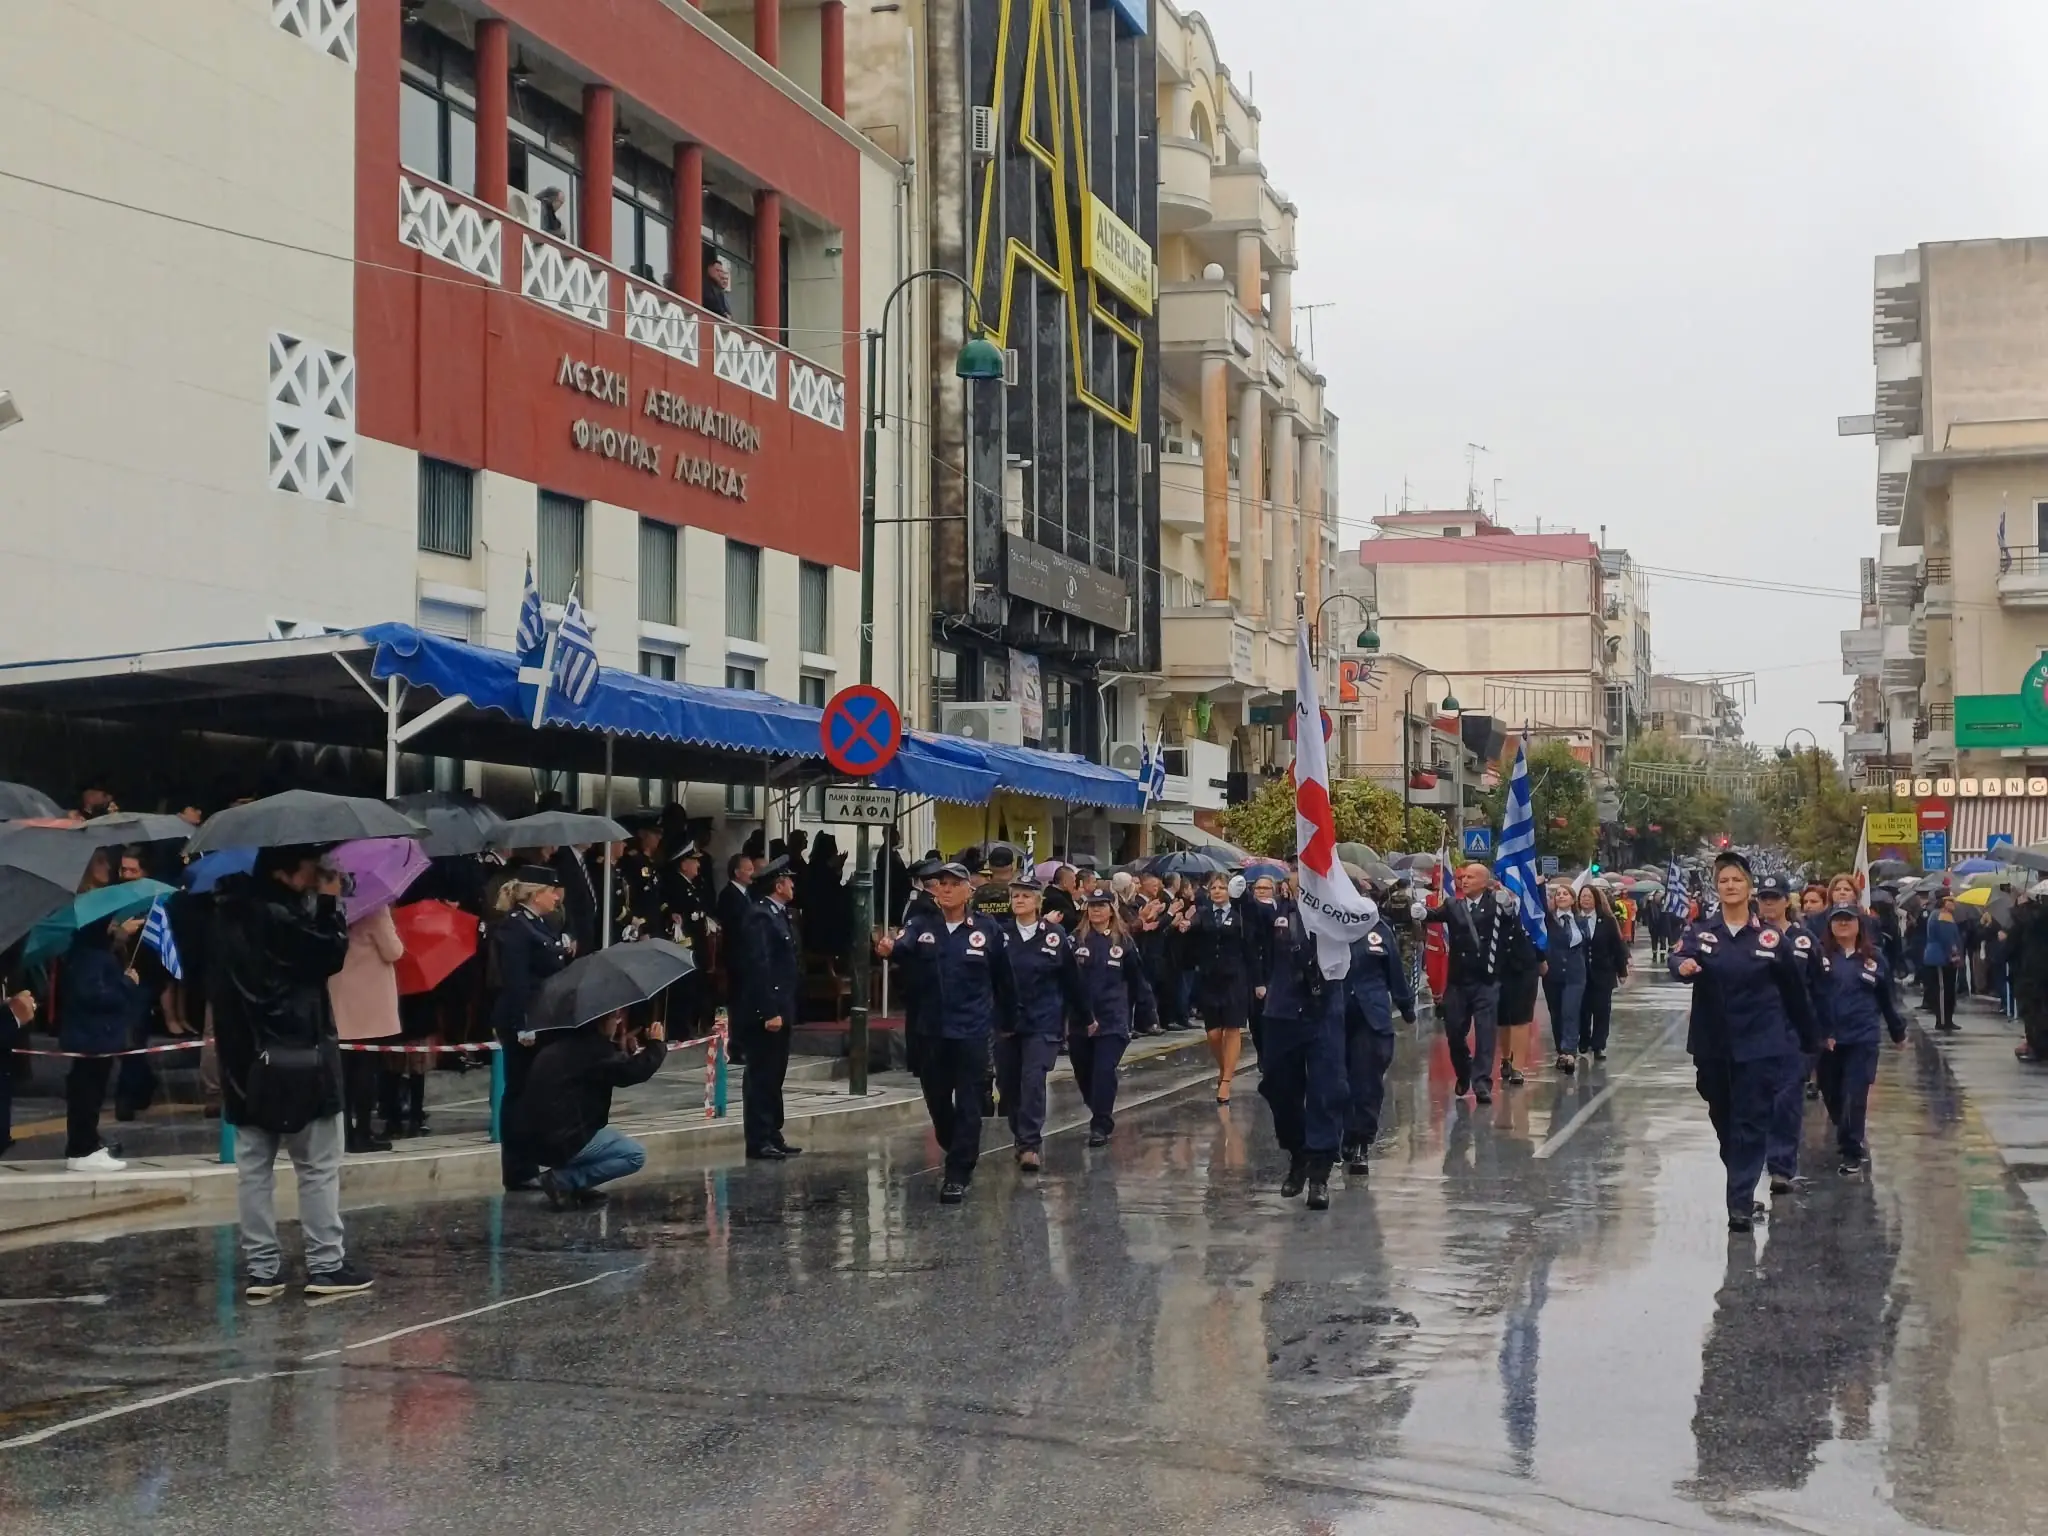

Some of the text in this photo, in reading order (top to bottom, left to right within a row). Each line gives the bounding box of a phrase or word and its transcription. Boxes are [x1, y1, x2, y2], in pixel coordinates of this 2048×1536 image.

[1097, 212, 1148, 282] ALTERLIFE
[557, 353, 761, 454] ΛΕΣΧΗ ΑΞΙΩΜΑΤΙΚΩΝ
[572, 418, 748, 503] ΦΡΟΥΡΑΣ ΛΑΡΙΣΑΣ
